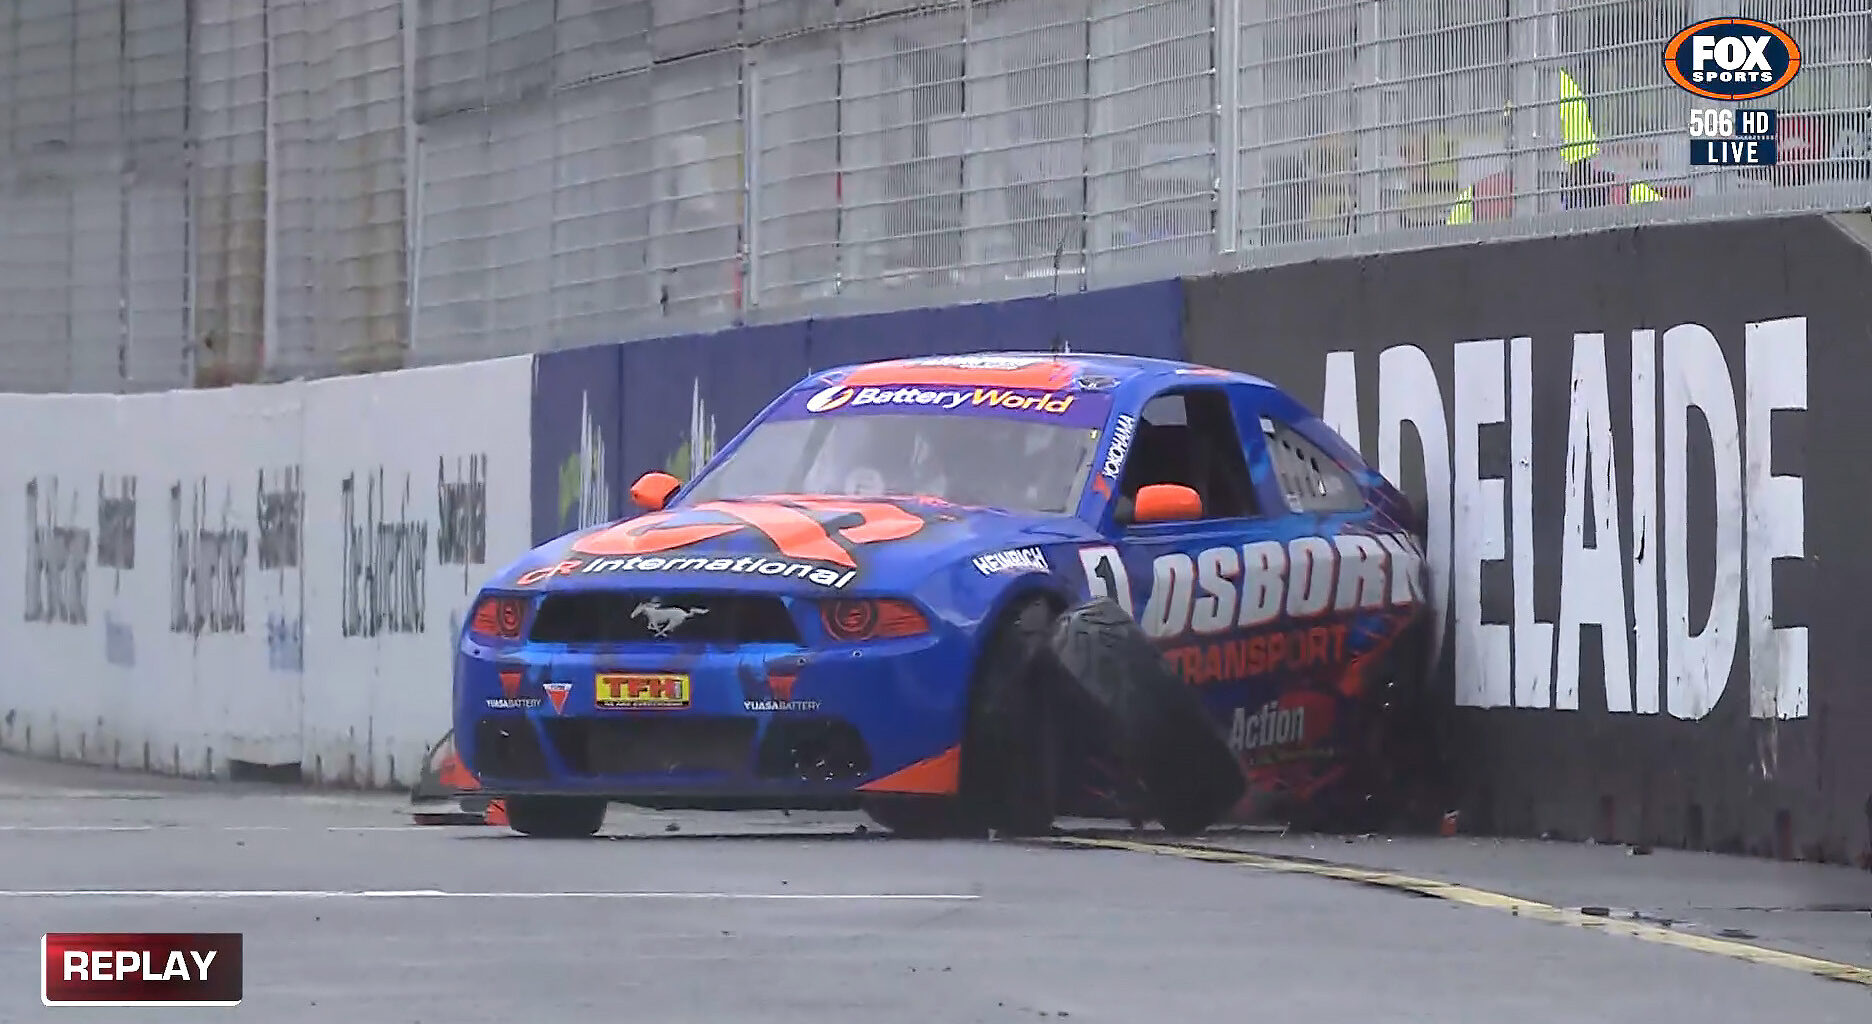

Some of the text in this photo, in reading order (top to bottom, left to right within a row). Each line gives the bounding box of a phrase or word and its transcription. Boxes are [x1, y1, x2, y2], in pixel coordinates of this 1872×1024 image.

[1101, 414, 1135, 480] YOKOHAMA
[582, 556, 858, 589] International
[972, 546, 1049, 575] HEINRICH
[1162, 624, 1347, 685] TRANSPORT
[1228, 701, 1305, 751] Action
